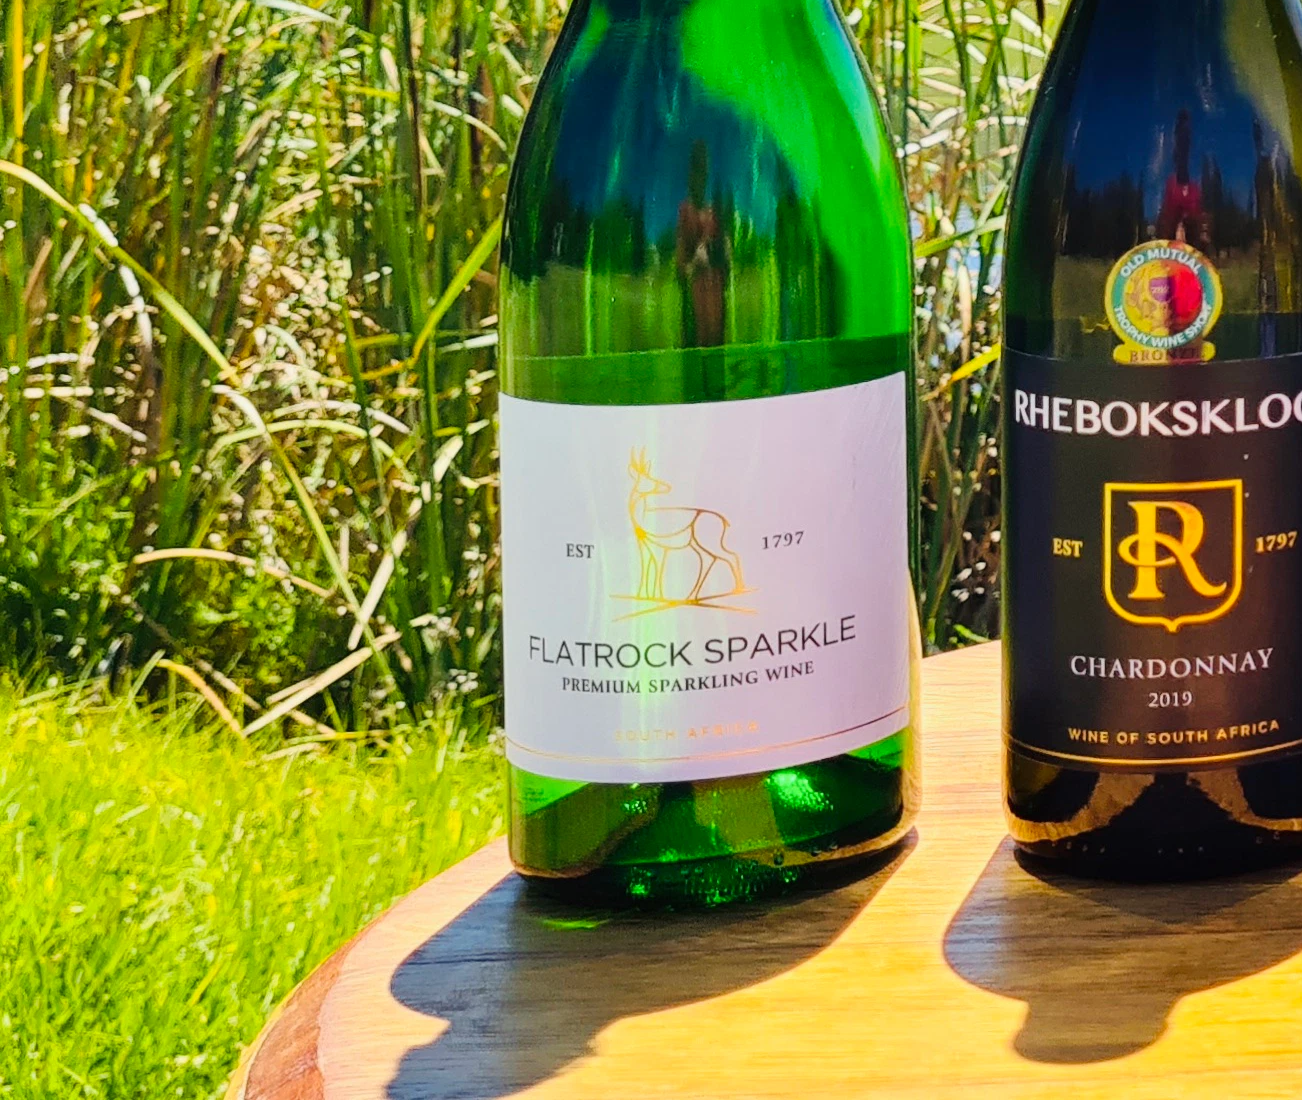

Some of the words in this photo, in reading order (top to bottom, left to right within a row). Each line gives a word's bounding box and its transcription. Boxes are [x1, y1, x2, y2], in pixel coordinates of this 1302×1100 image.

[1120, 252, 1146, 278] OLD
[1147, 247, 1202, 275] MUTUAL
[1114, 304, 1151, 345] TROPHY
[1151, 333, 1187, 348] WINE
[566, 542, 595, 560] EST
[761, 530, 806, 550] 1797
[1052, 536, 1084, 558] EST
[1255, 530, 1299, 554] 1797
[1118, 500, 1228, 599] R
[529, 634, 693, 670] FLATROCK
[704, 613, 857, 664] SPARKLE
[562, 676, 642, 694] PREMIUM
[648, 669, 759, 693] SPARKLING
[765, 660, 815, 682] WINE
[1069, 646, 1275, 680] CHARDONNAY
[1148, 691, 1194, 709] 2019
[614, 729, 678, 742] SOUTH
[687, 720, 760, 738] AFRICA
[1068, 726, 1109, 744] WINE
[1116, 730, 1140, 746] OF
[1147, 729, 1209, 746] SOUTH
[1216, 718, 1280, 741] AFRICA
